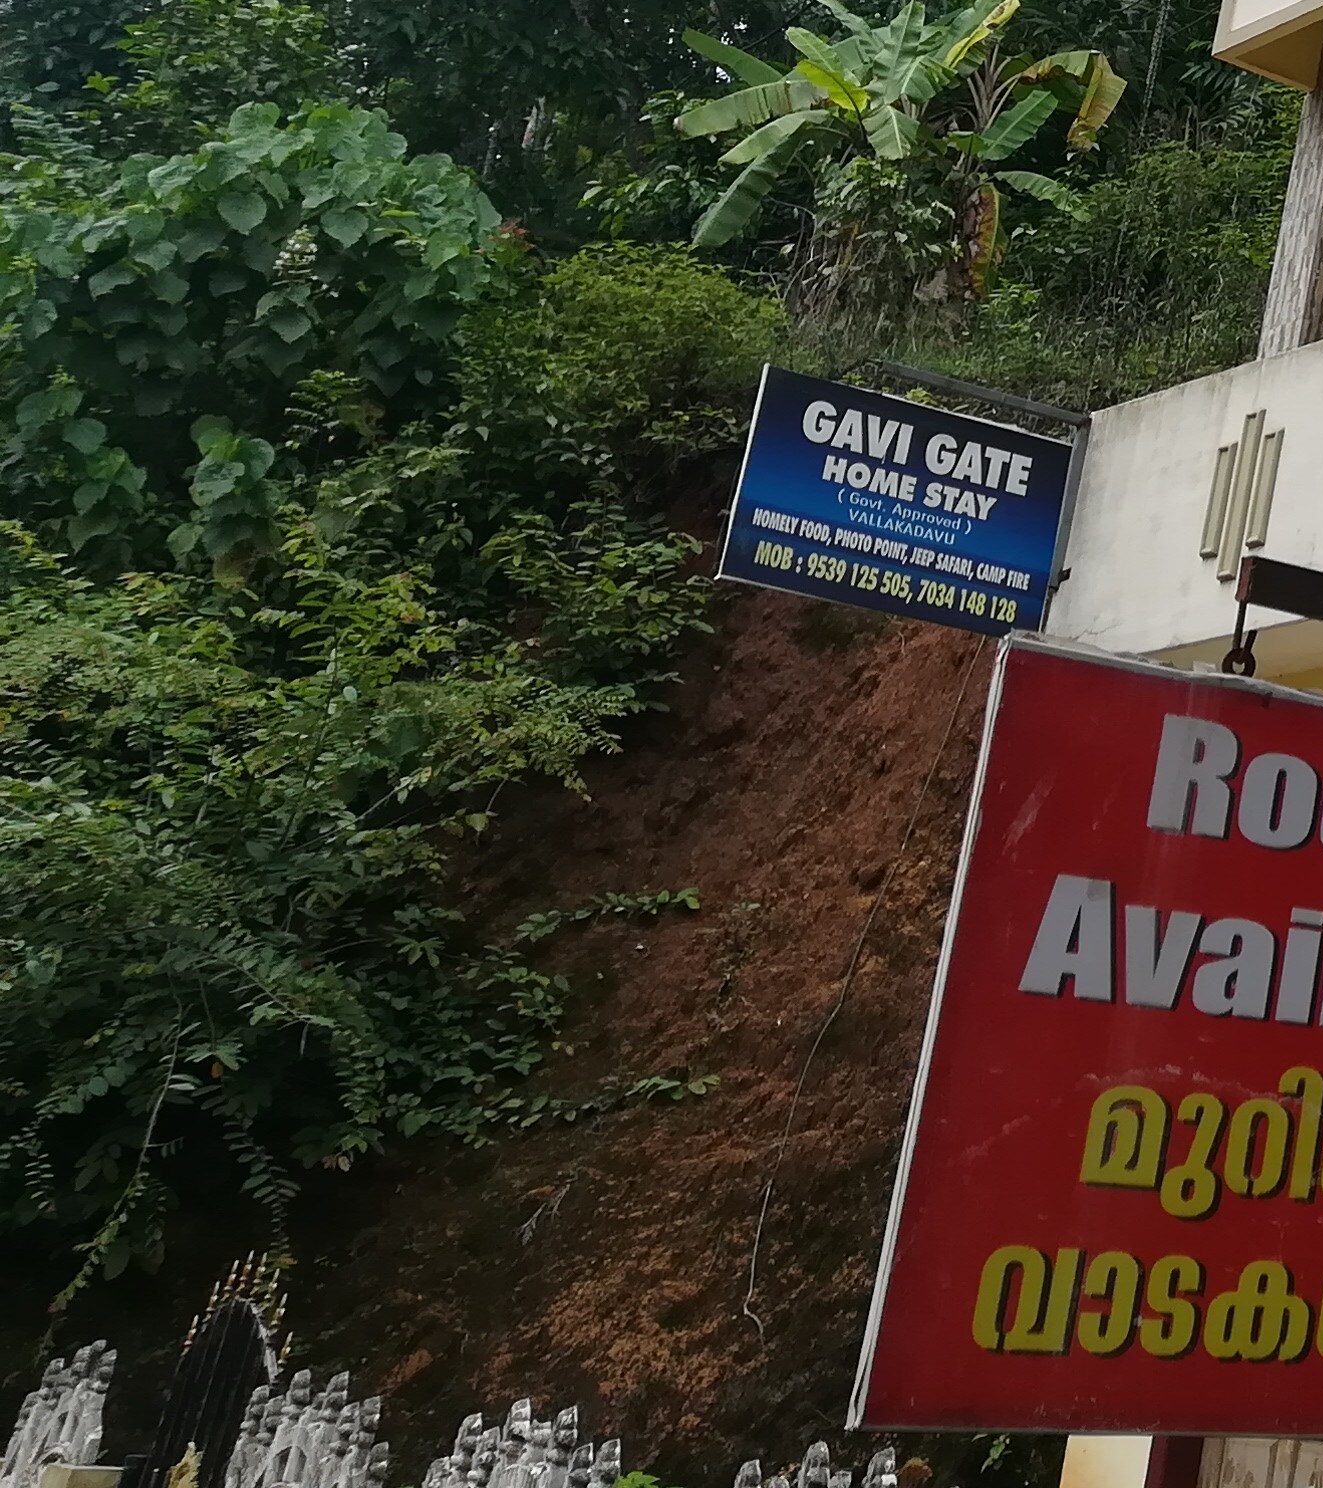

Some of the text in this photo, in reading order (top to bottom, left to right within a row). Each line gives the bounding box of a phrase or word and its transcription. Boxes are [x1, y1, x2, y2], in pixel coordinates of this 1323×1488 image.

[802, 400, 1032, 496] GAVI GATE
[822, 456, 997, 520] HOME STAY
[850, 492, 887, 513] Govt.
[892, 504, 961, 530] Approved
[752, 508, 1030, 591] HOMELY FOOD, PHOTO POINT, JEEP SAFARI, CAMP FIRE
[849, 509, 956, 544] VALLAKADAVU
[754, 541, 793, 570] MOB
[807, 553, 846, 583] 9539
[850, 564, 879, 590] 125
[880, 572, 912, 603] 505,
[917, 580, 954, 608] 7034
[959, 589, 986, 616] 148
[990, 596, 1017, 623] 128
